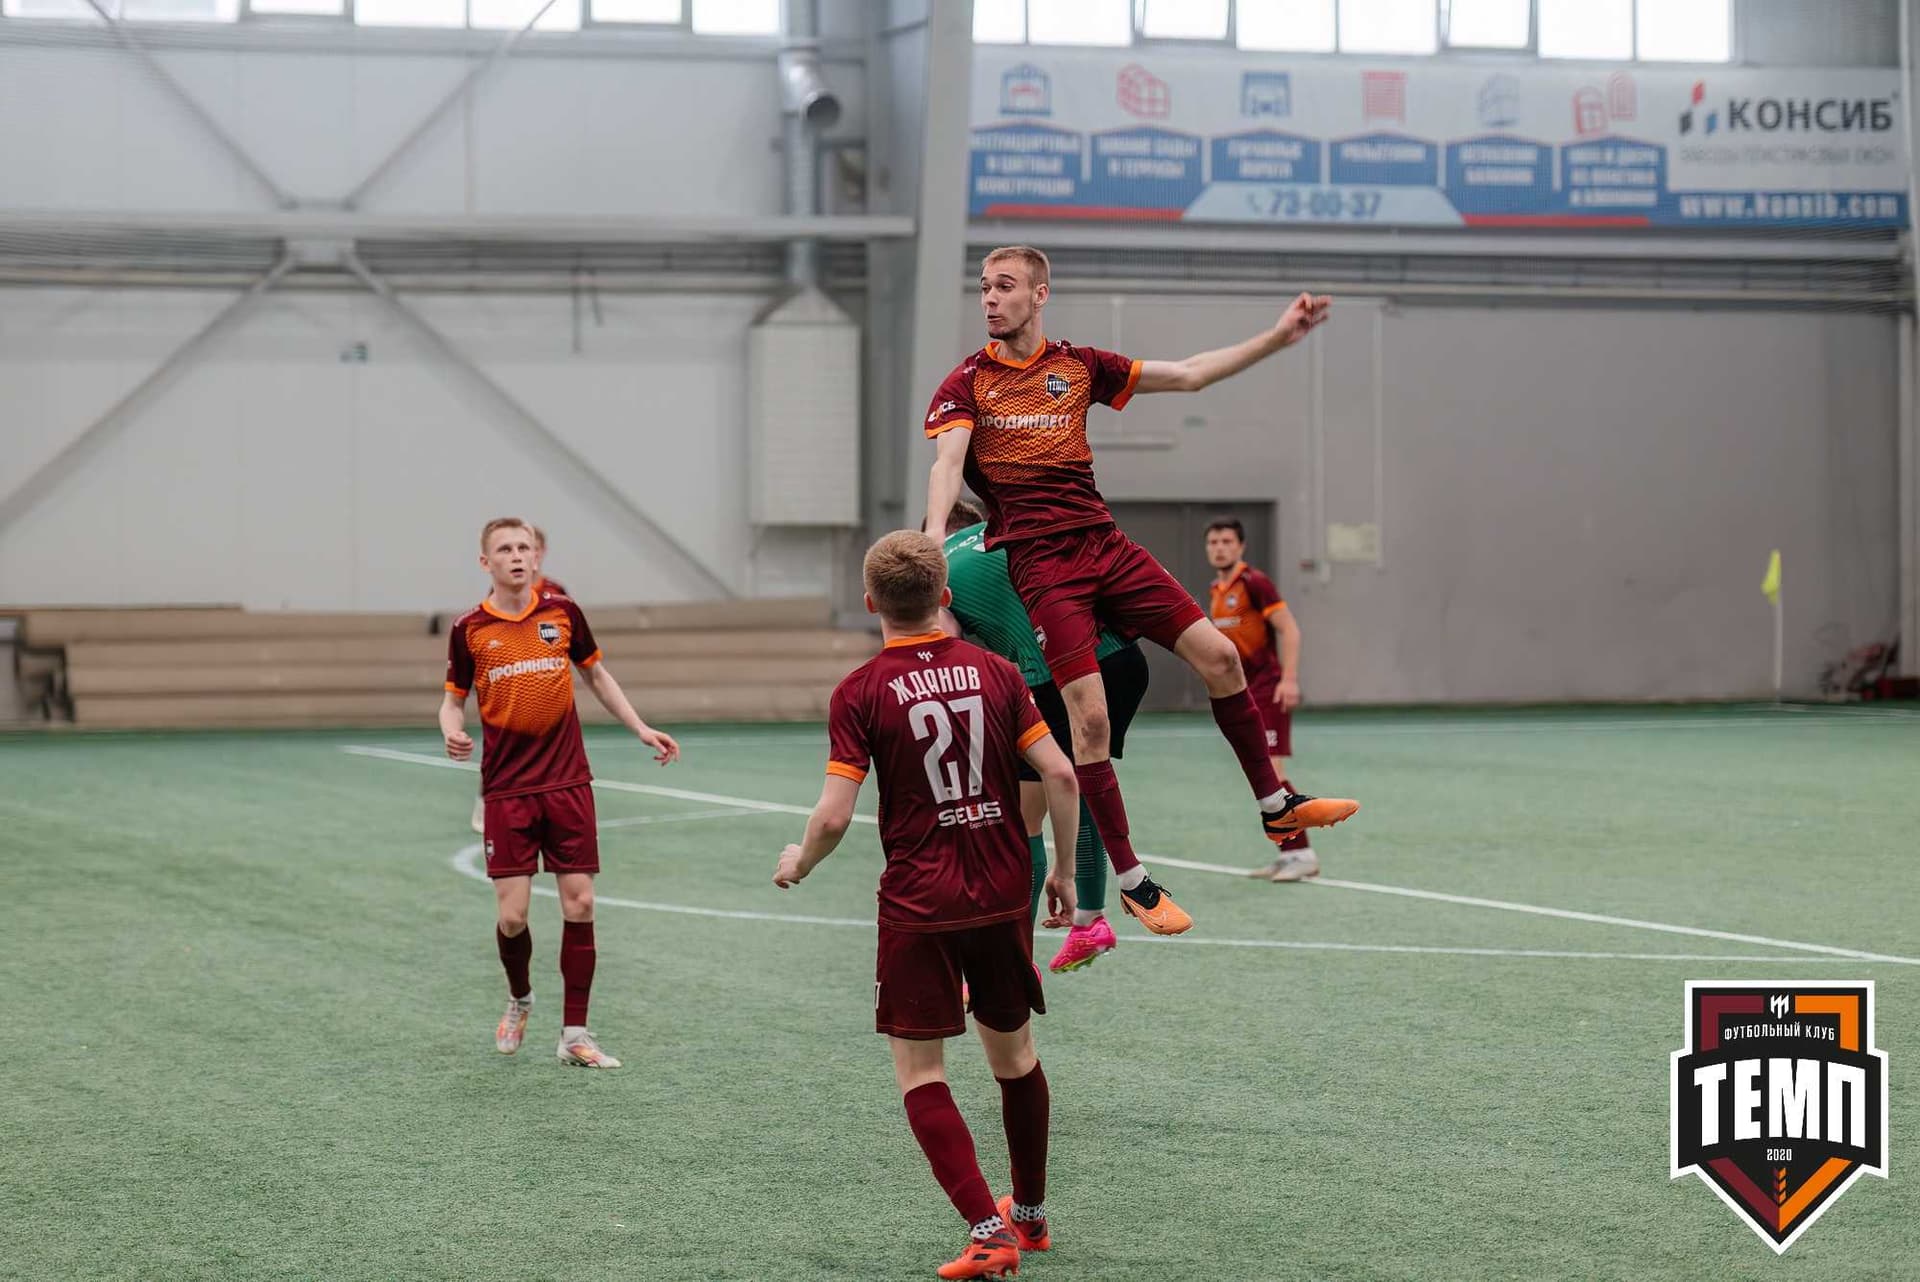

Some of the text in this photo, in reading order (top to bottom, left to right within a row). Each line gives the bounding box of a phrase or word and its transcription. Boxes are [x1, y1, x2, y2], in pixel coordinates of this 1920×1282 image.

[1728, 99, 1894, 131] КОНСИБ
[887, 665, 981, 705] ЖДАНОВ
[908, 695, 984, 804] 27
[938, 801, 1002, 827] SEUS
